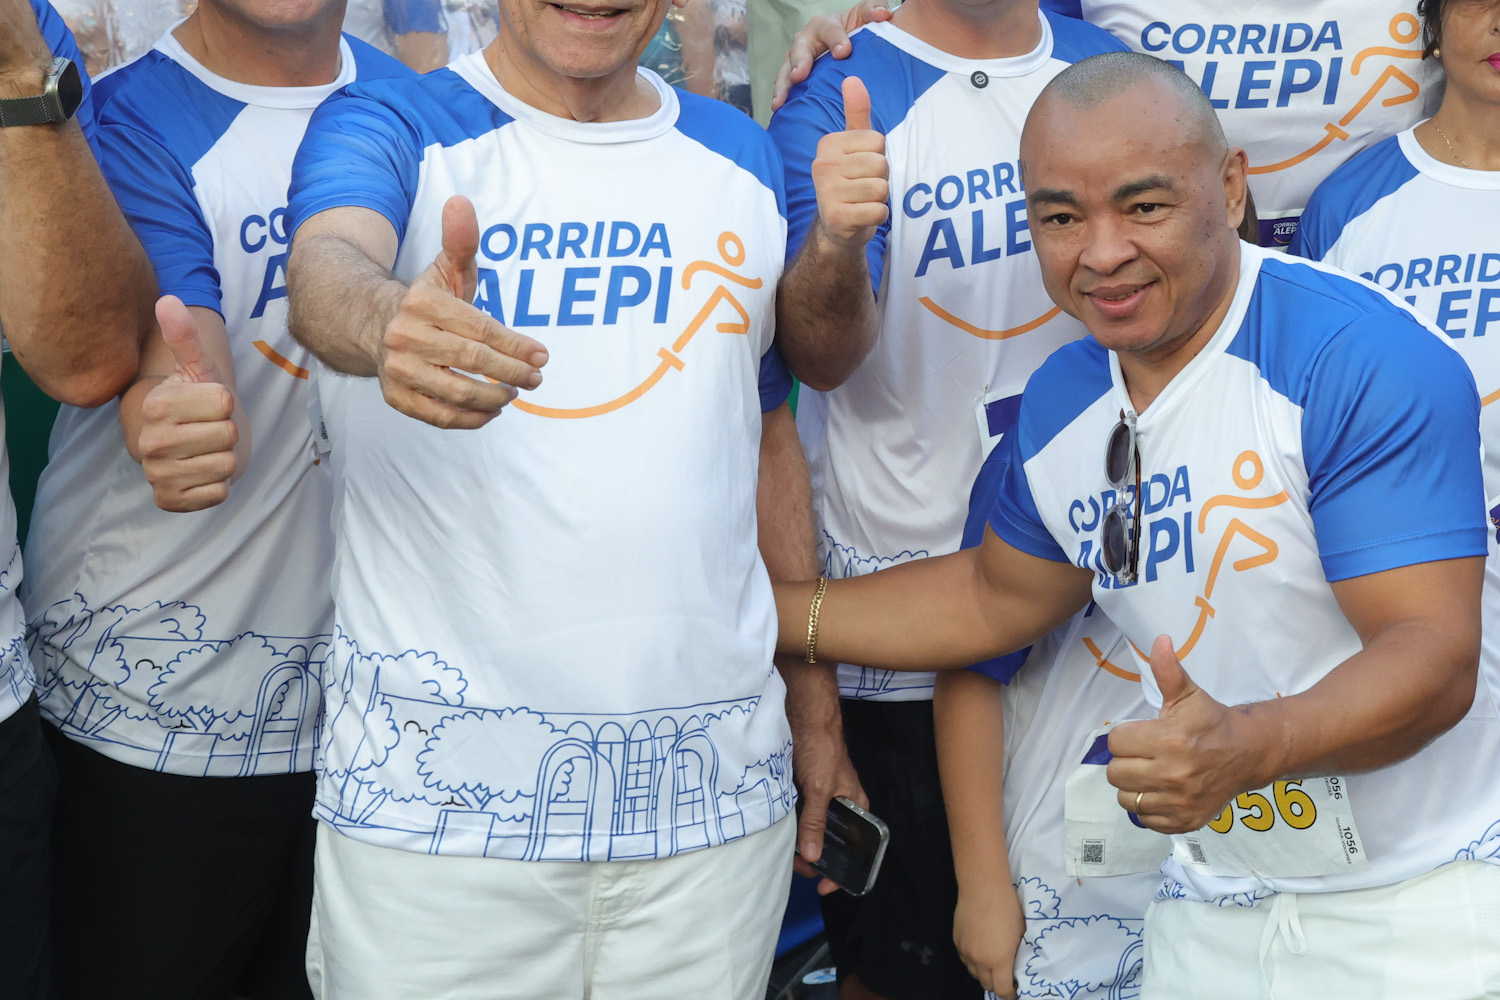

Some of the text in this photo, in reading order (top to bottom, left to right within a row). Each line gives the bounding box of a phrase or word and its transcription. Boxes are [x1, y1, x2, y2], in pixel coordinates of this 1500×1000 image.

[1140, 20, 1343, 55] CORRIDA
[1165, 57, 1343, 109] LEPI
[479, 221, 671, 261] ORRIDA
[1330, 777, 1343, 800] 056
[1343, 826, 1358, 854] 1056
